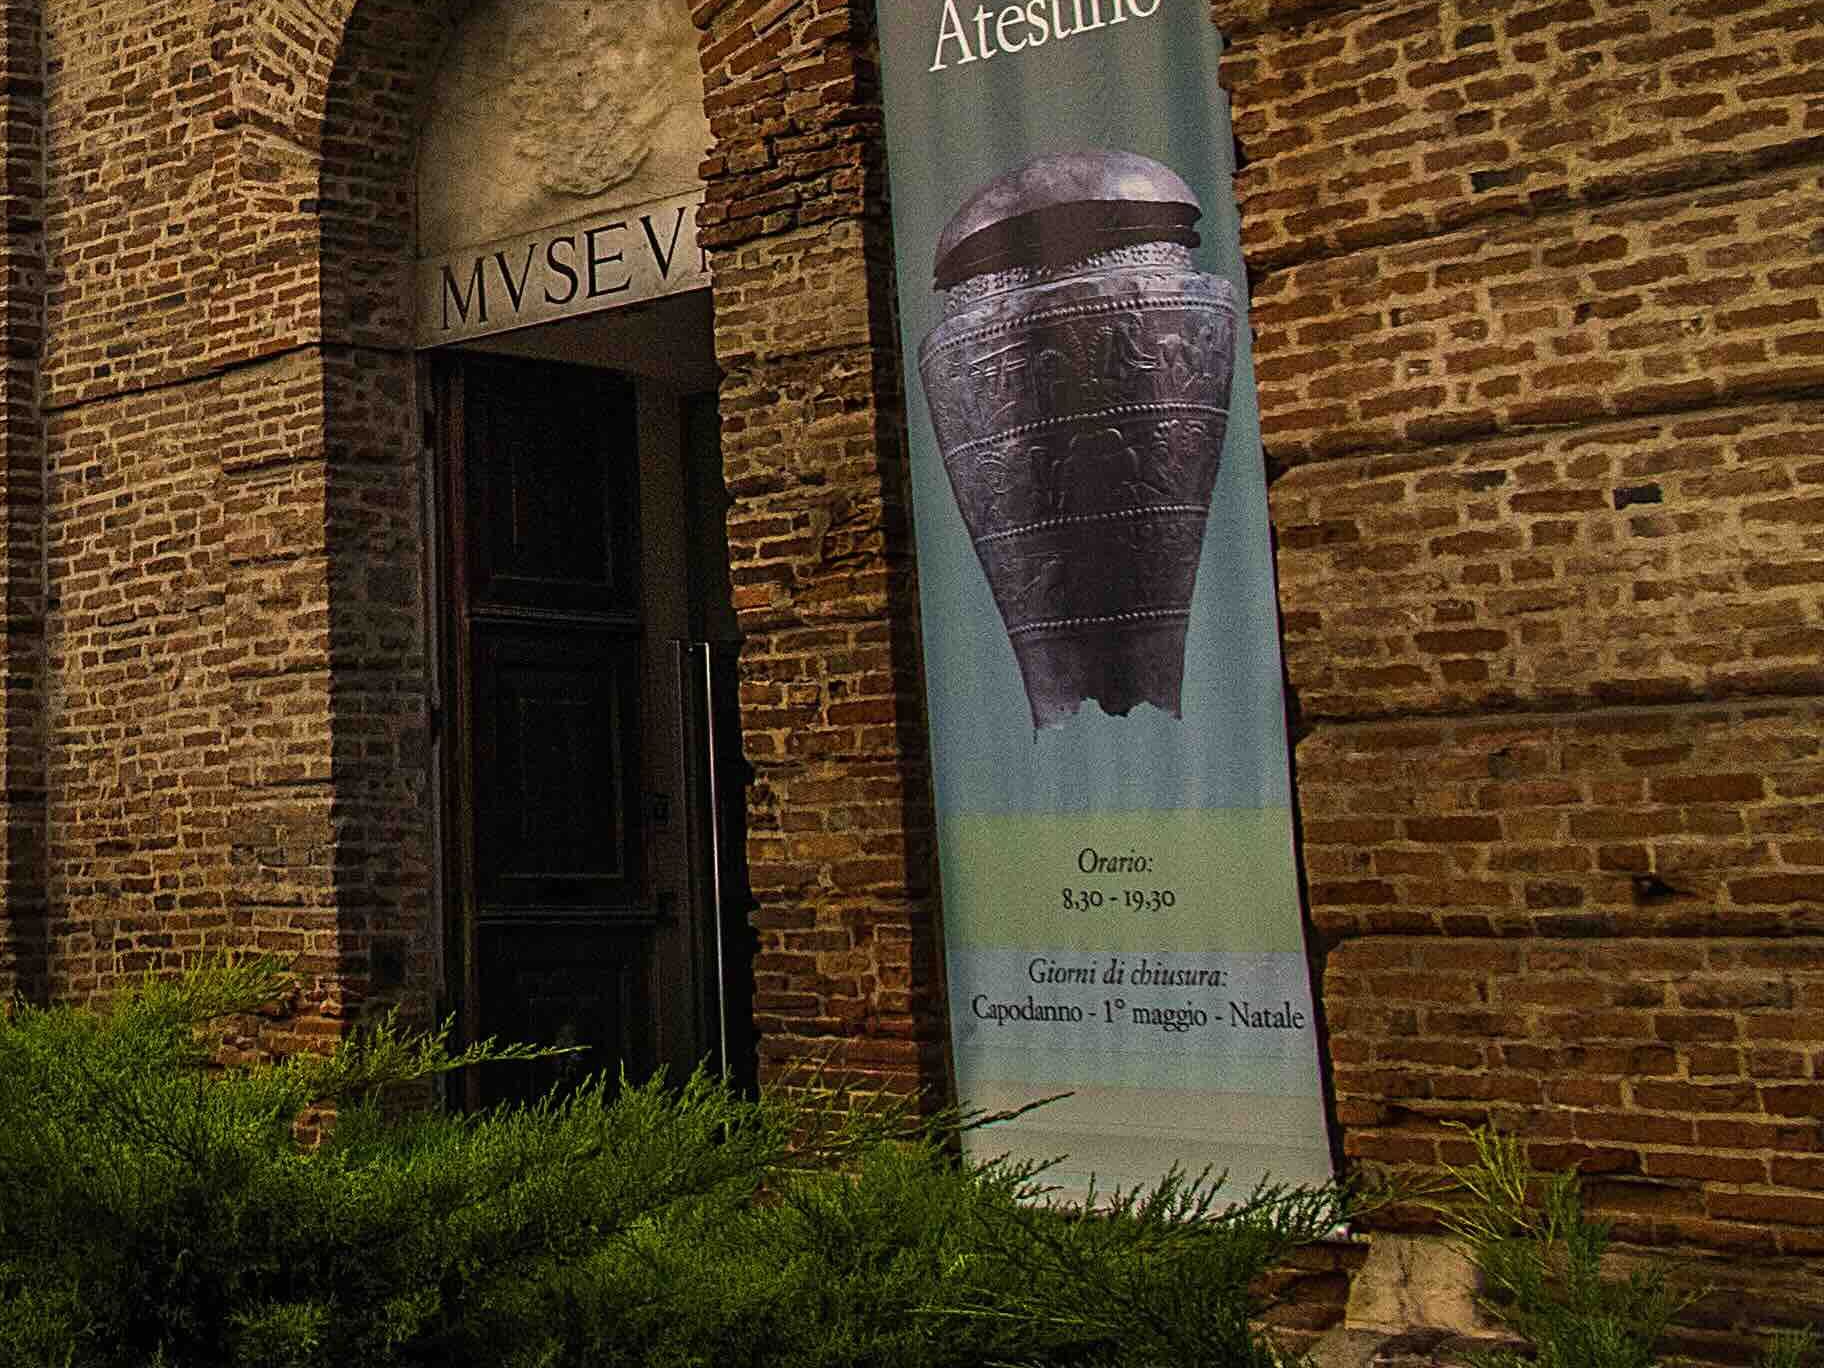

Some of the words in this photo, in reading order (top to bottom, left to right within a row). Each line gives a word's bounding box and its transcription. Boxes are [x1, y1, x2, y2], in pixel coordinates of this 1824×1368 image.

[439, 202, 712, 330] MVSEV
[1078, 847, 1153, 873] Orario:
[1028, 957, 1097, 985] Giorni
[1102, 958, 1126, 985] di
[1130, 958, 1229, 987] chiusura:
[972, 994, 1083, 1026] Capodanno
[1132, 1000, 1208, 1032] maggio
[1229, 1000, 1305, 1030] Natale
